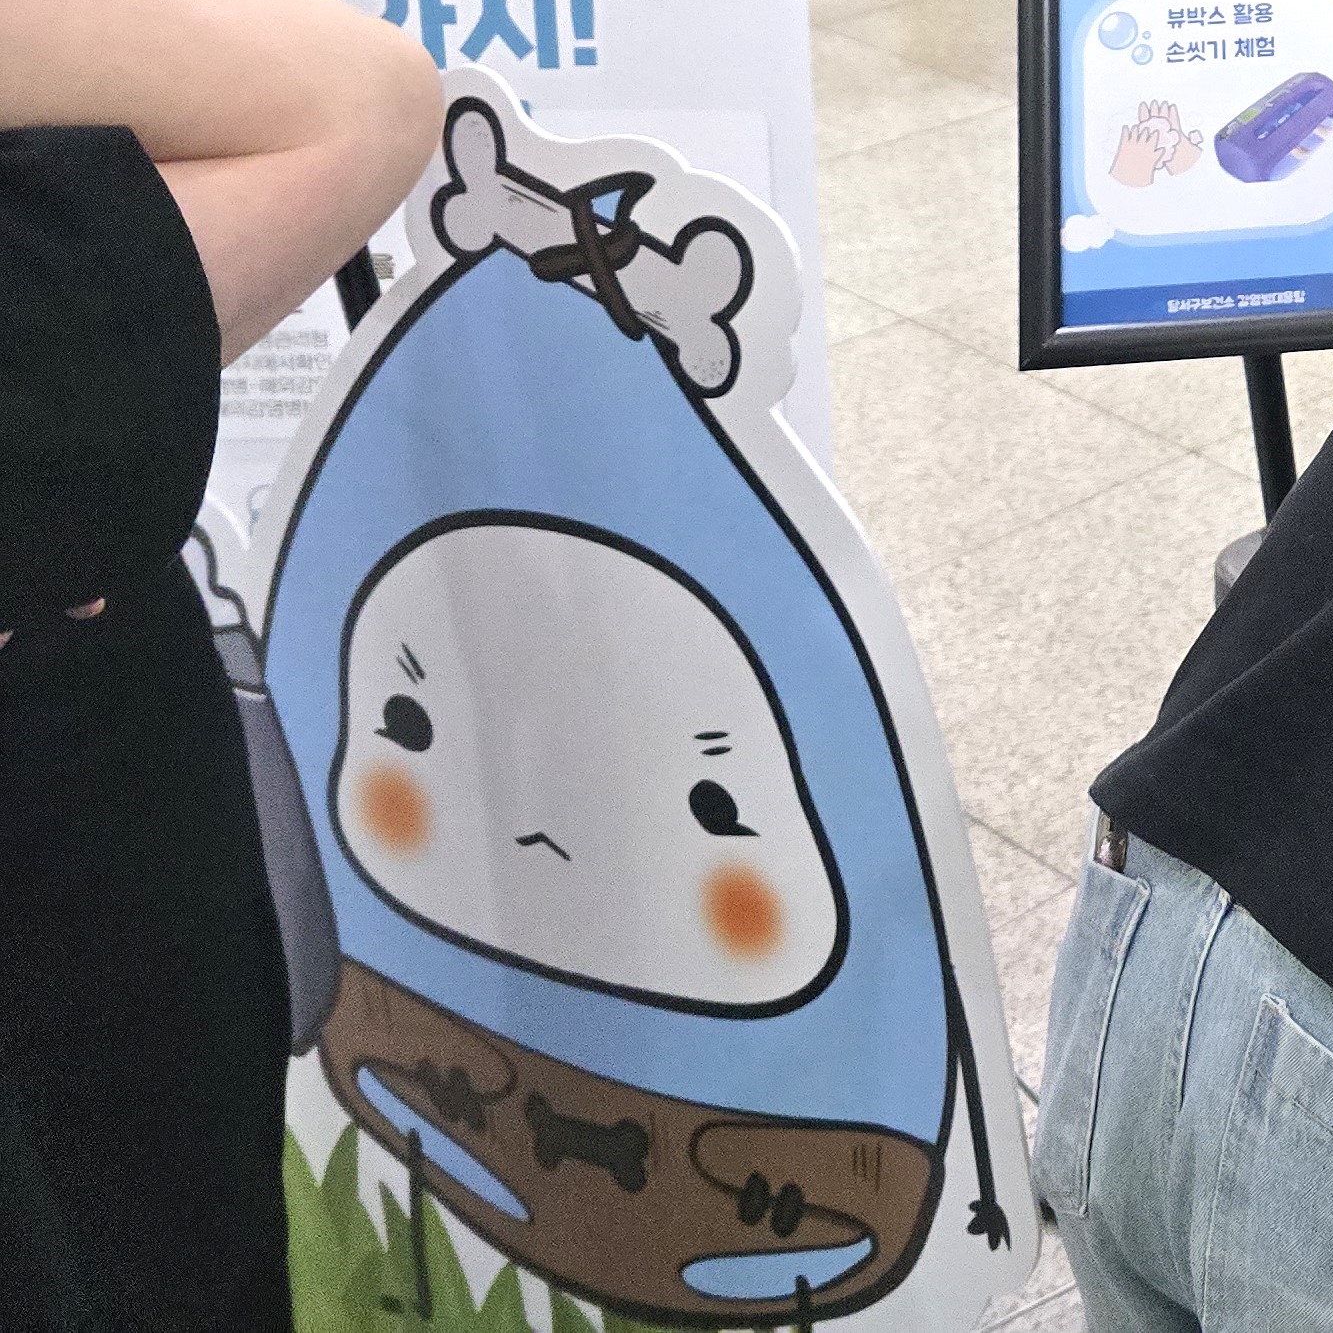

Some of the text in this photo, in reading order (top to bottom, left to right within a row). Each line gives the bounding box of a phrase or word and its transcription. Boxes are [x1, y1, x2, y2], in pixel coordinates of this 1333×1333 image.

[1167, 3, 1273, 29] 뷰박스 활용
[1166, 36, 1275, 63] 손씻기 체험
